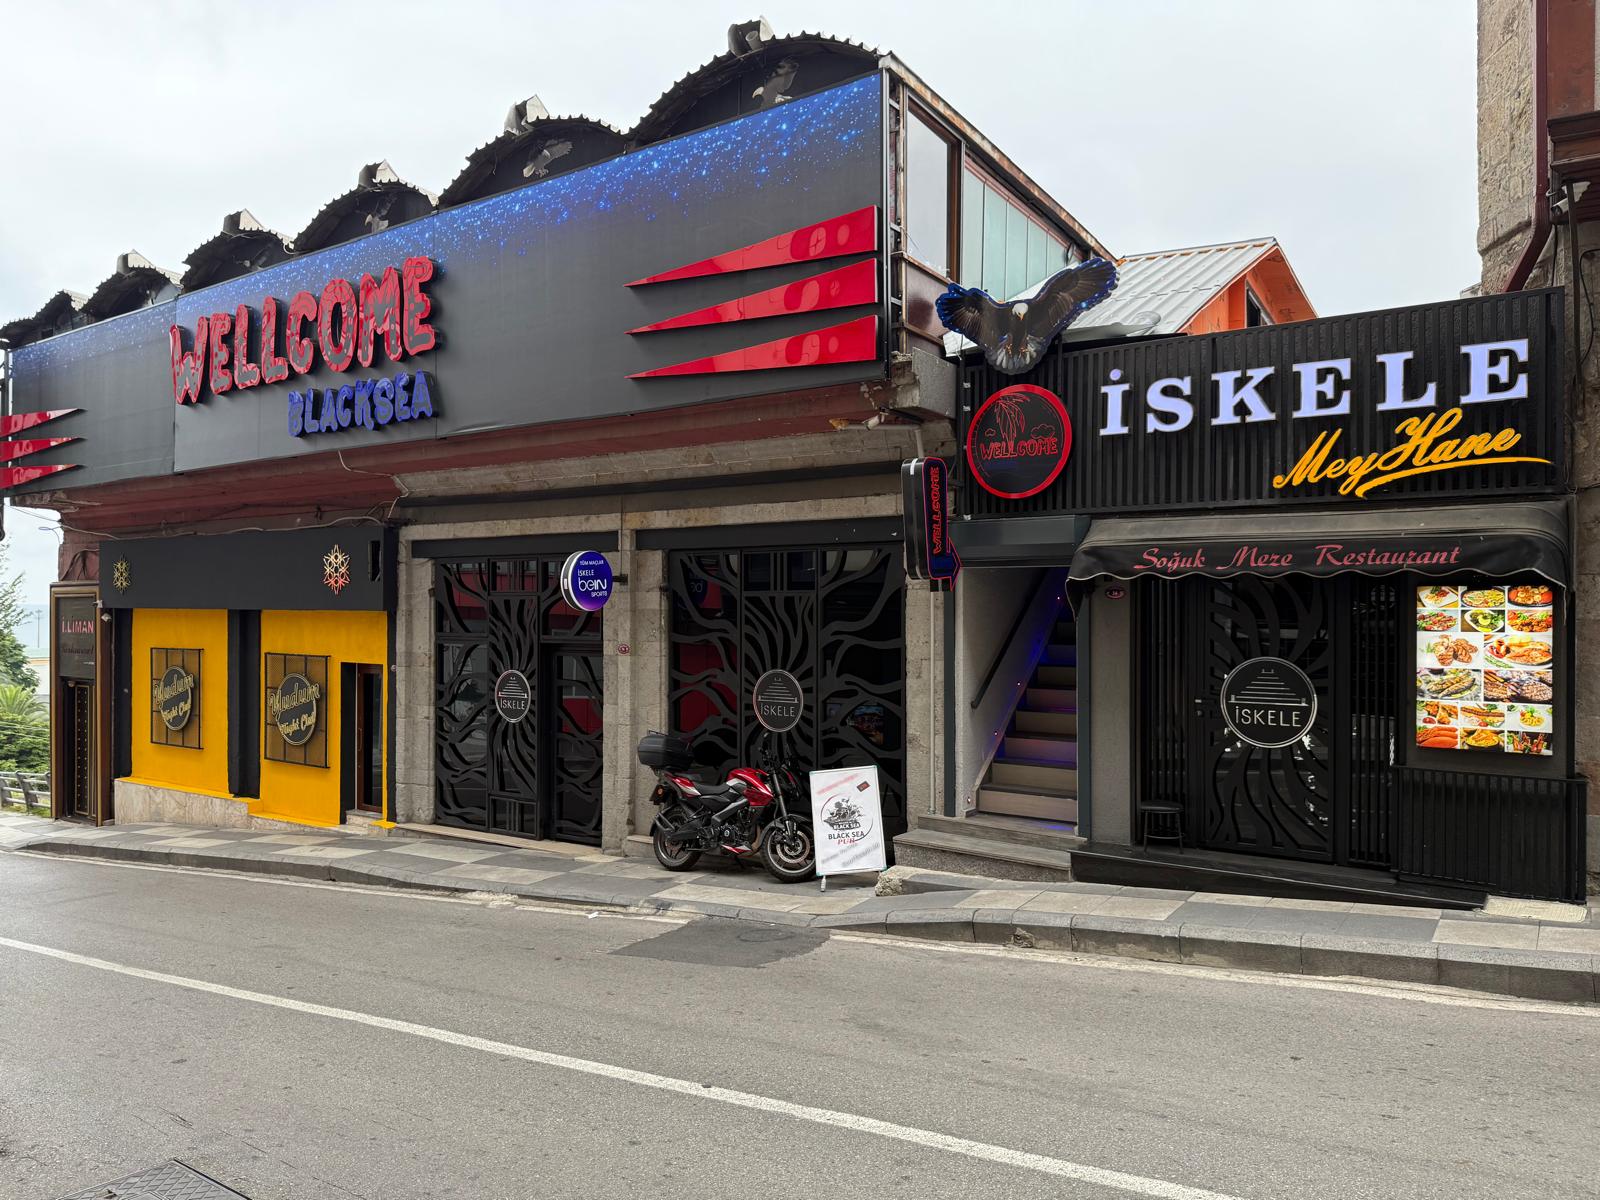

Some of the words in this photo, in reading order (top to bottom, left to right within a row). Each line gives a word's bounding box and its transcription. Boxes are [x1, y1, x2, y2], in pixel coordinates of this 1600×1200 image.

[169, 256, 435, 404] WELLCOME
[1099, 338, 1530, 436] İSKELE
[980, 437, 1058, 461] WELLCOME
[928, 466, 943, 555] WELLCOME
[1133, 546, 1206, 574] Soğuk
[1312, 543, 1463, 568] Restaurant
[1235, 705, 1302, 727] İSKELE
